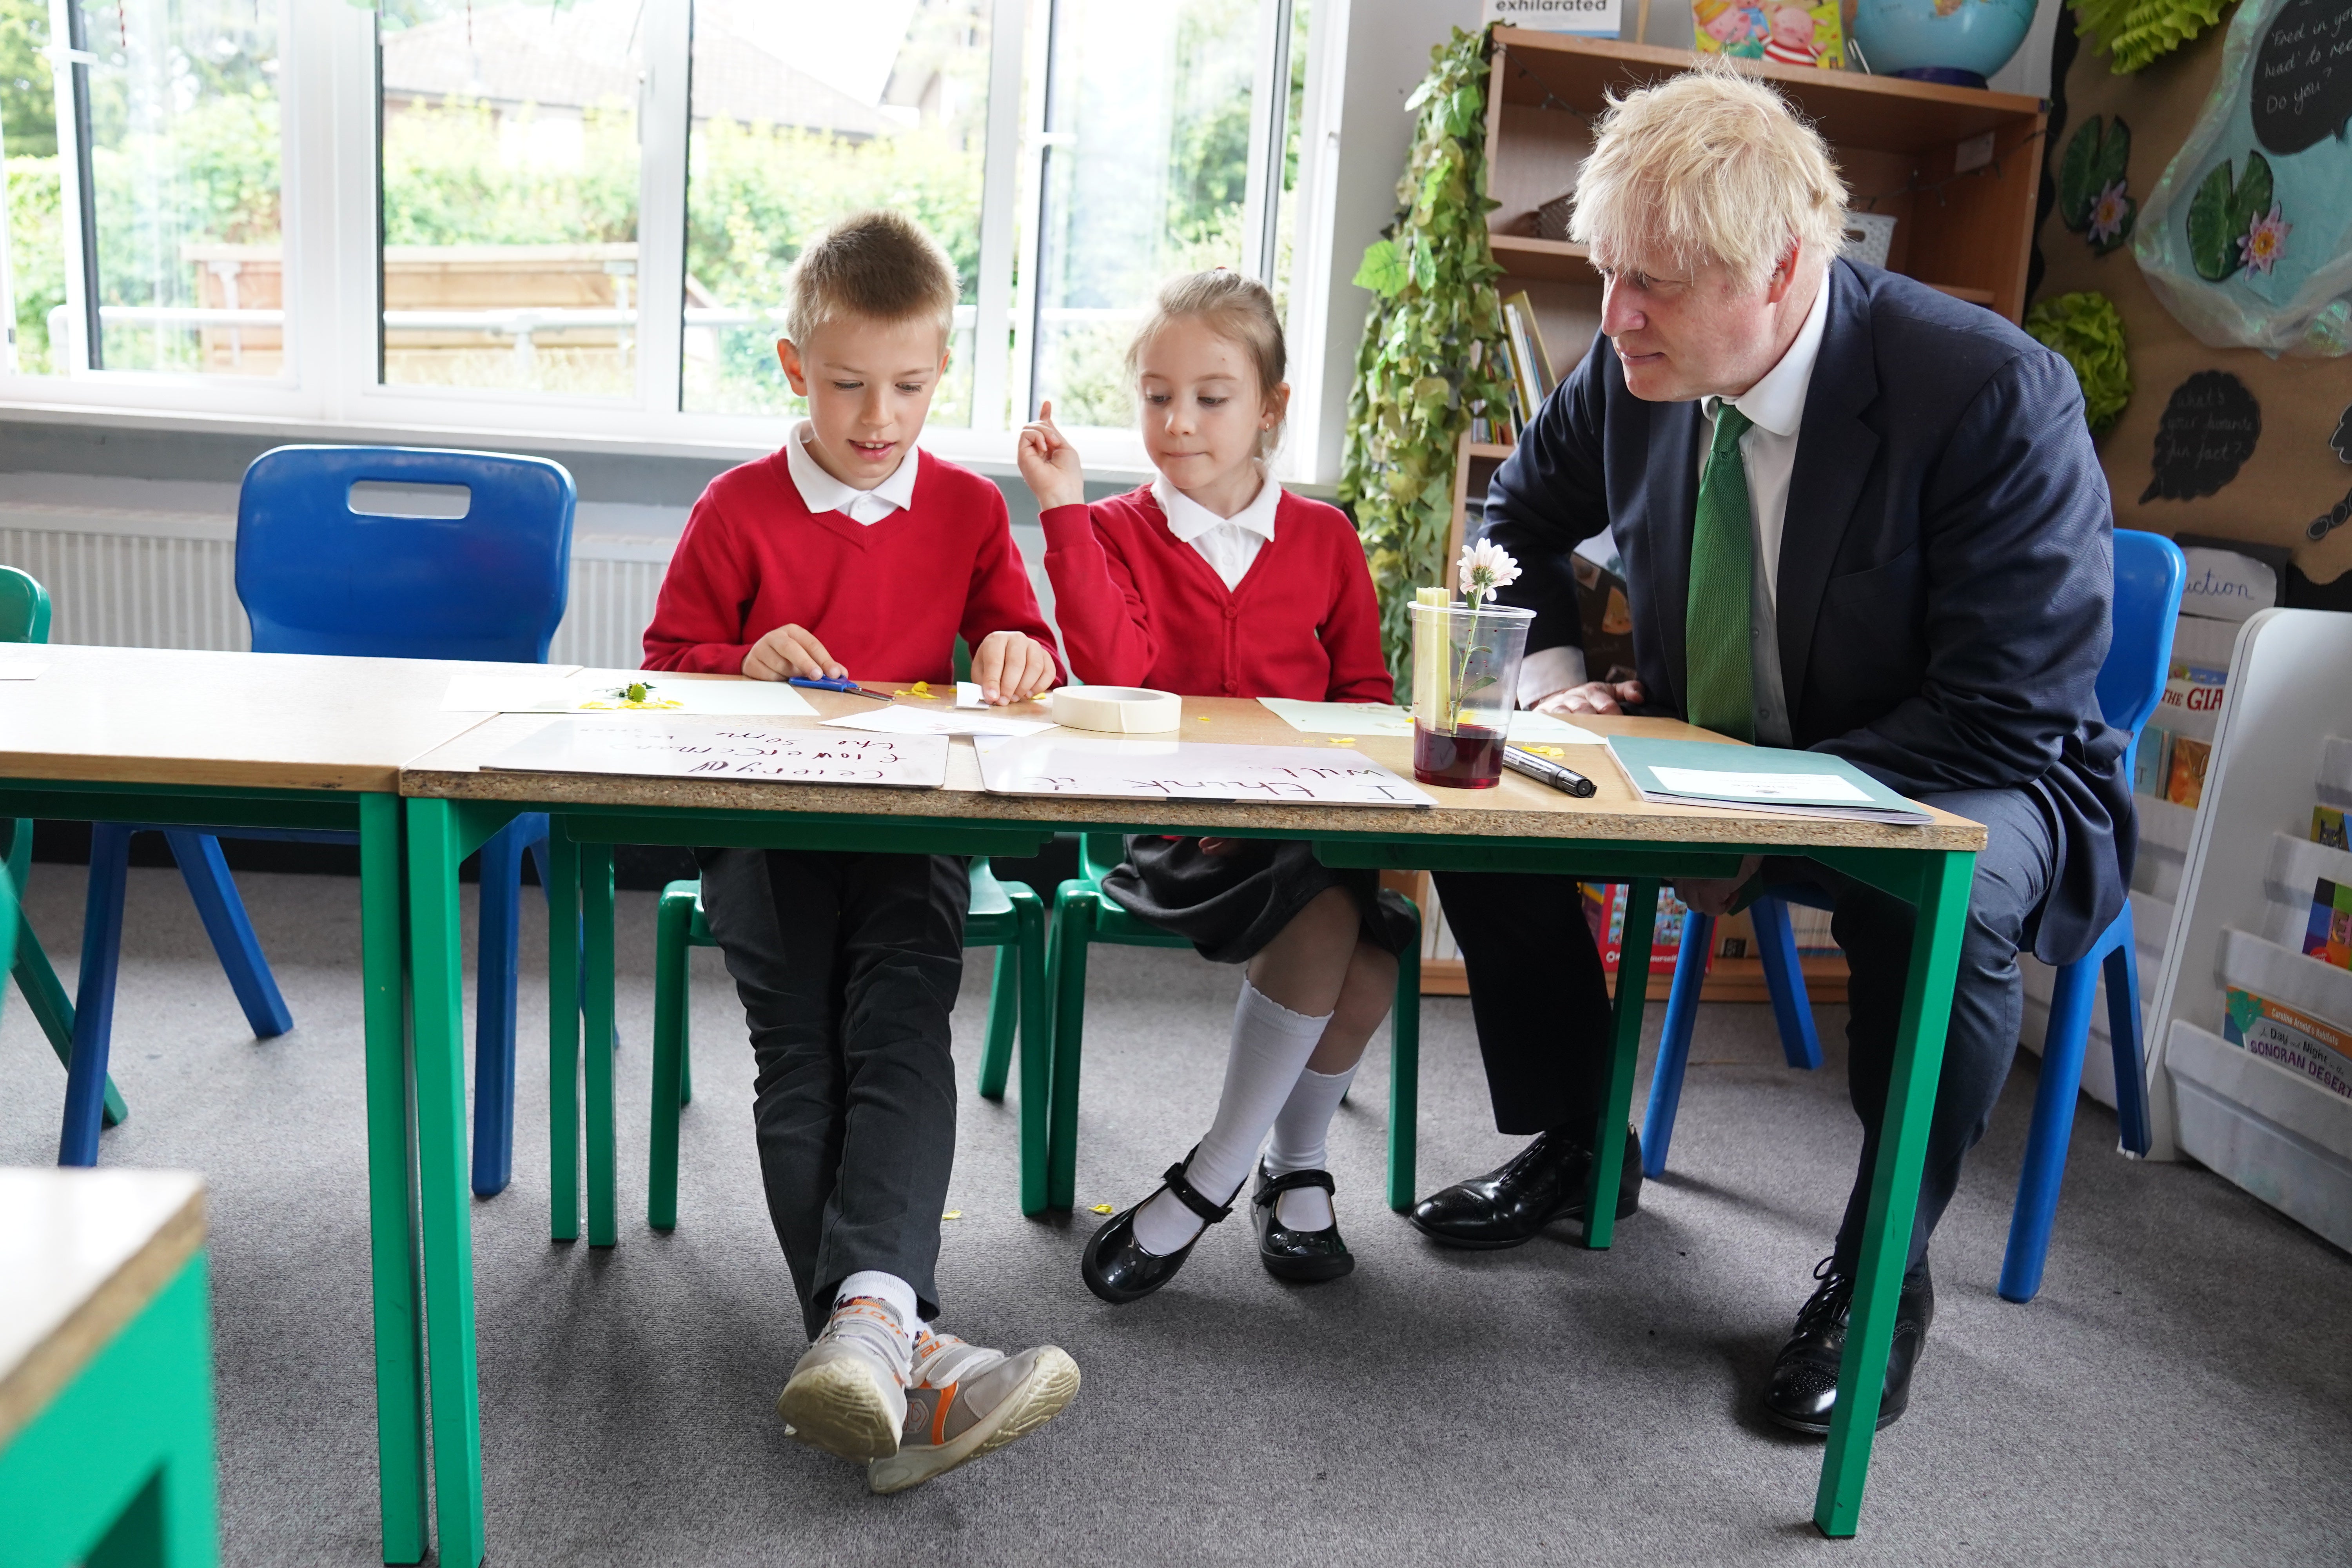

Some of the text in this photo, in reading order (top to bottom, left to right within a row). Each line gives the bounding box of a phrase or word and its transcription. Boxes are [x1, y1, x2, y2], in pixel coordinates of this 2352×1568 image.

[1496, 0, 1606, 11] exhilarated
[2313, 19, 2328, 35] in
[2305, 45, 2321, 67] to
[2267, 94, 2287, 114] Do
[2184, 568, 2254, 601] iction
[2161, 687, 2223, 711] THE GIA
[833, 740, 895, 750] the
[1122, 779, 1315, 798] think
[1356, 785, 1414, 800] I
[2271, 1007, 2293, 1025] Caroline
[2316, 1027, 2339, 1046] Habitats
[2270, 1028, 2288, 1045] Day
[2303, 1040, 2328, 1063] Night
[2250, 1040, 2352, 1098] SONORAN DESERT
